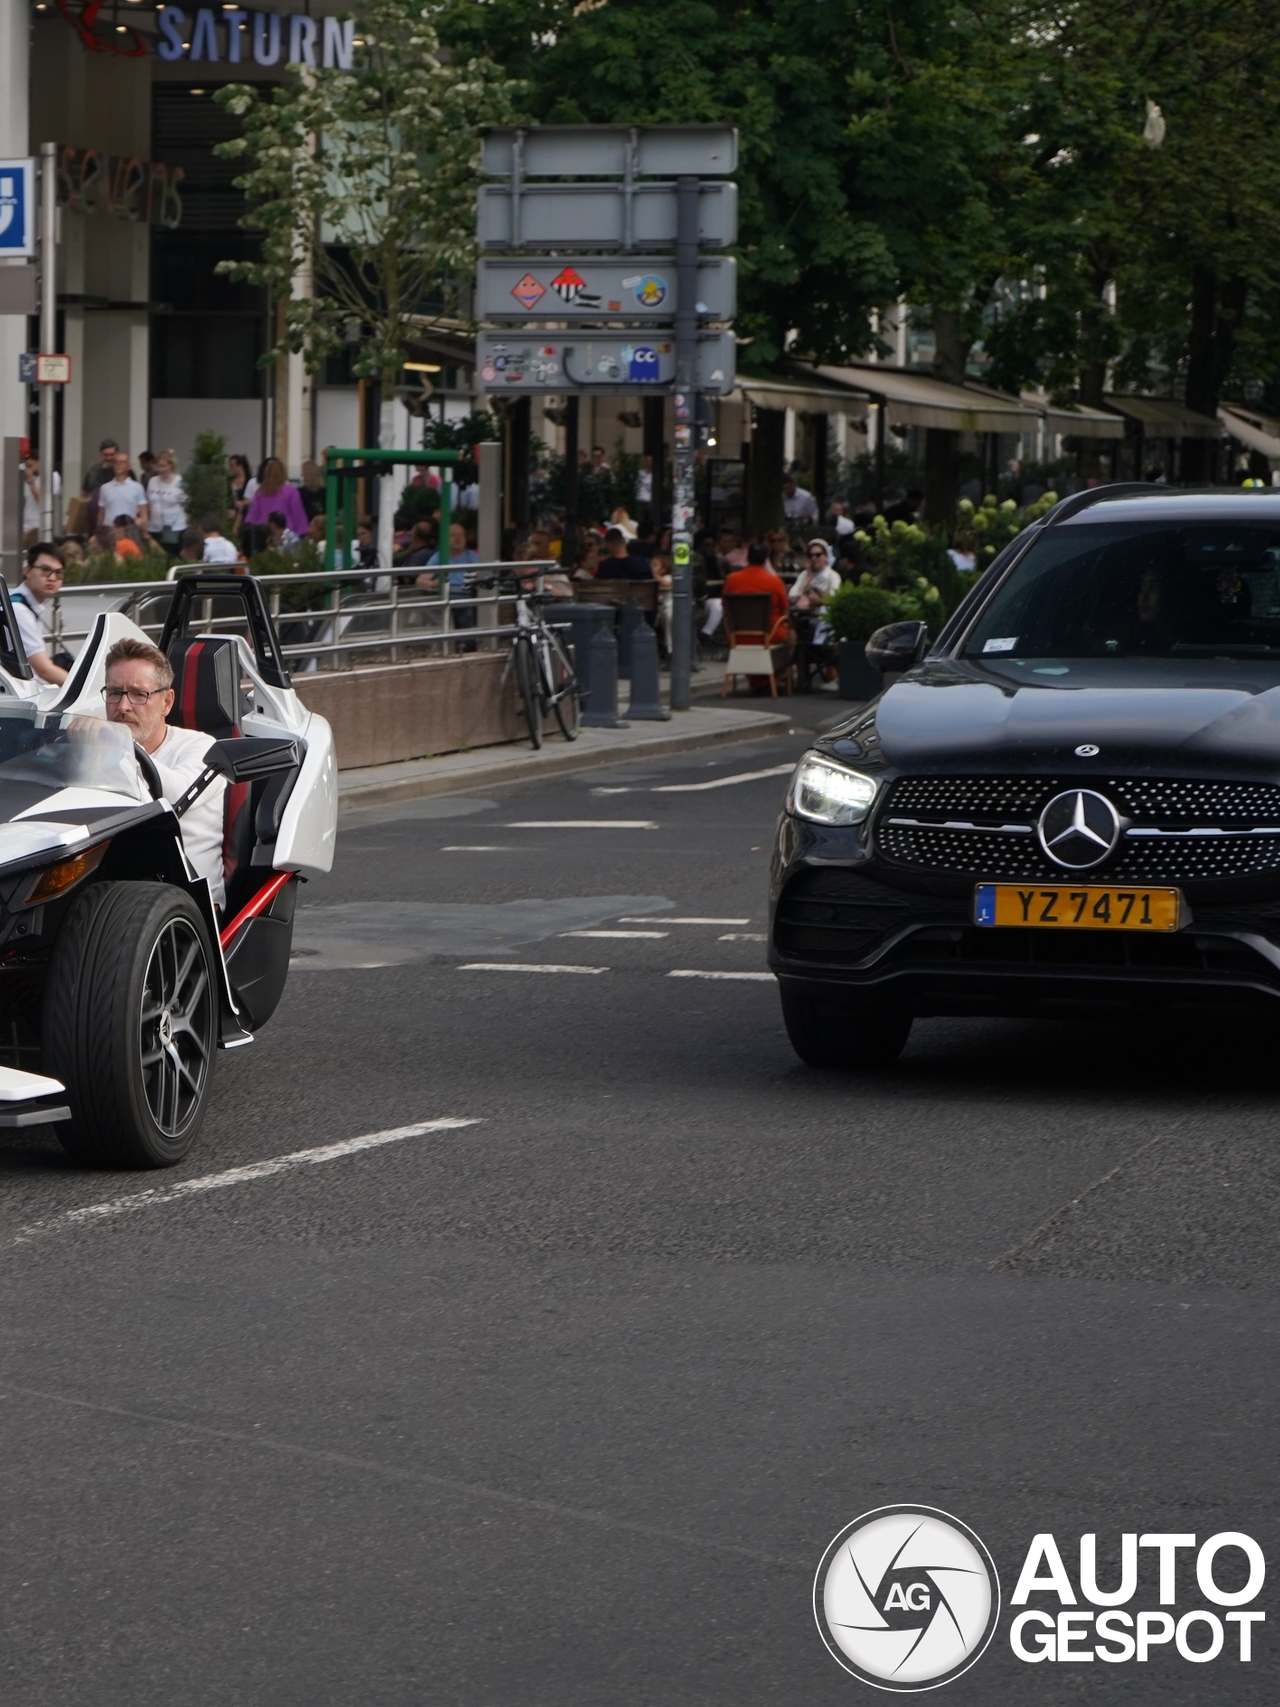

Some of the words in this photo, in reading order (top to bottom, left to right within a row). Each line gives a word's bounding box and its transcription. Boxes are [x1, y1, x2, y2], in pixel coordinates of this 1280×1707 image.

[158, 5, 356, 70] SATURN
[1016, 890, 1060, 922] YZ
[1069, 891, 1154, 925] 7471
